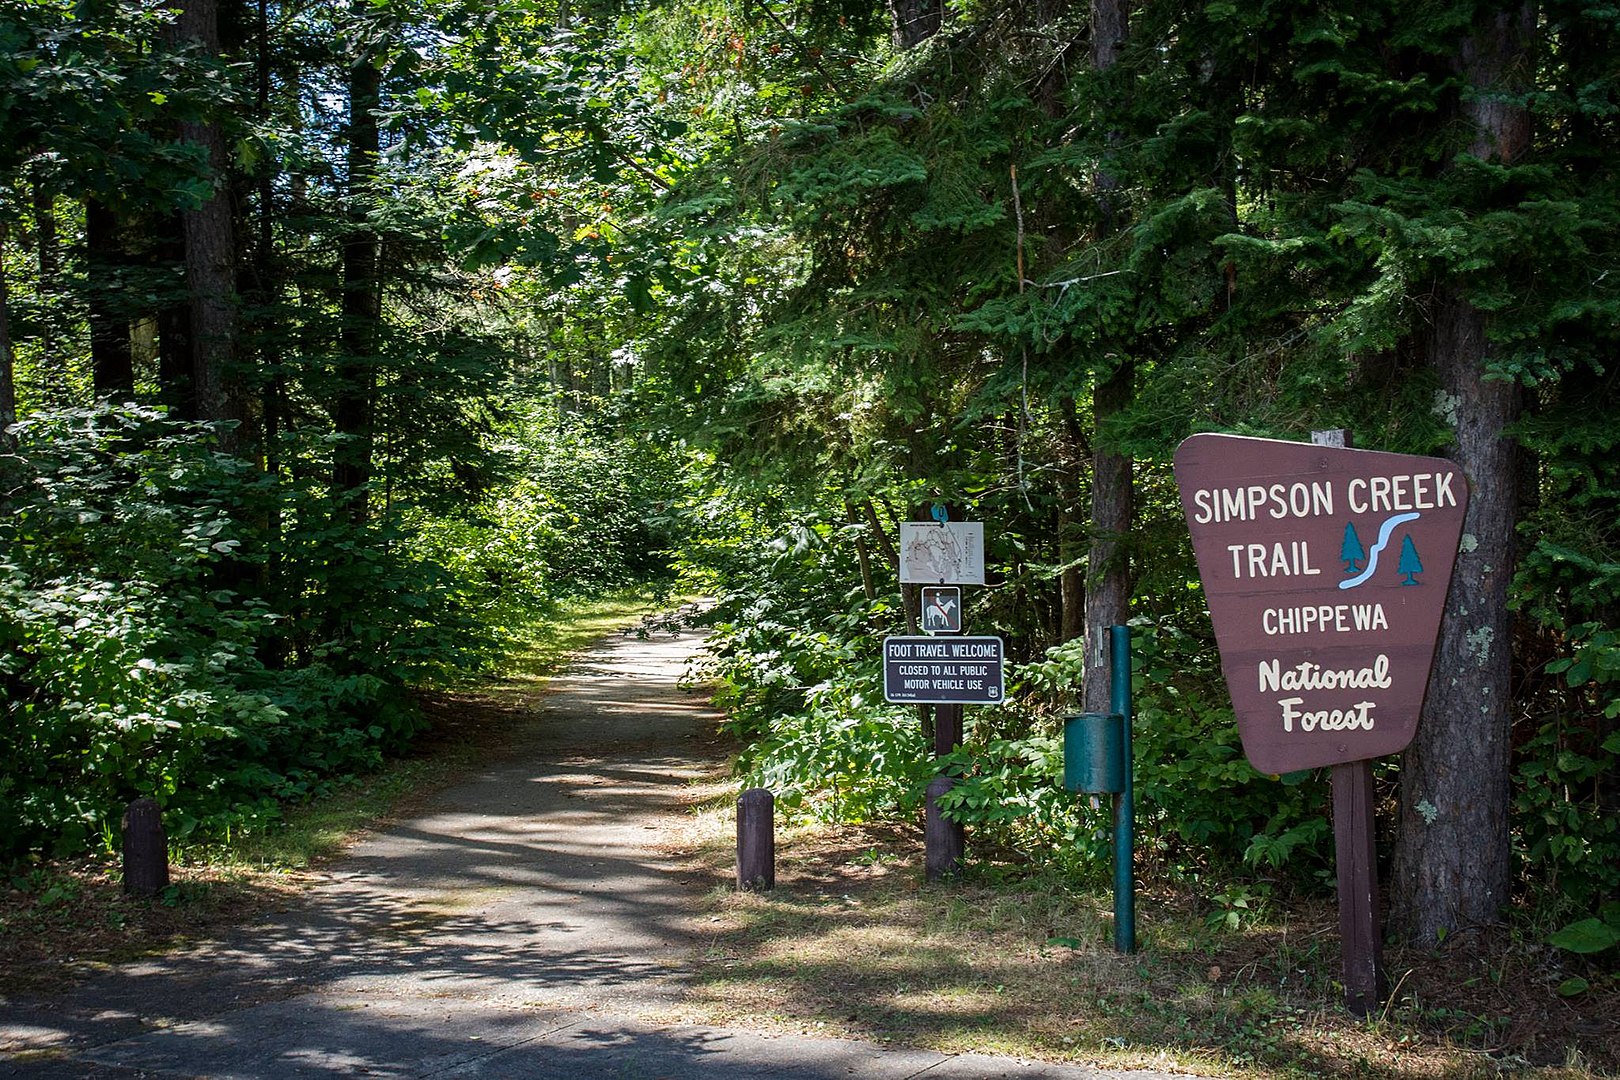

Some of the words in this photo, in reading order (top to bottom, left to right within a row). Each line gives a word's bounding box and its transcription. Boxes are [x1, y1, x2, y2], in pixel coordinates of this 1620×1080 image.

[1194, 481, 1333, 523] SIMPSON
[1348, 472, 1457, 514] CREEK
[1227, 541, 1321, 578] TRAIL
[1262, 603, 1389, 635] CHIPPEWA
[889, 644, 911, 657] FOOT
[914, 644, 949, 657] TRAVEL
[952, 644, 998, 657] WELCOME
[899, 665, 928, 676] CLOSED
[931, 665, 940, 676] TO
[943, 665, 958, 676] ALL
[960, 665, 988, 676] PUBLIC
[904, 679, 930, 690] MOTOR
[932, 679, 964, 690] VEHICLE
[967, 679, 983, 690] USE
[1259, 654, 1392, 692] National
[1277, 697, 1376, 732] Forest
